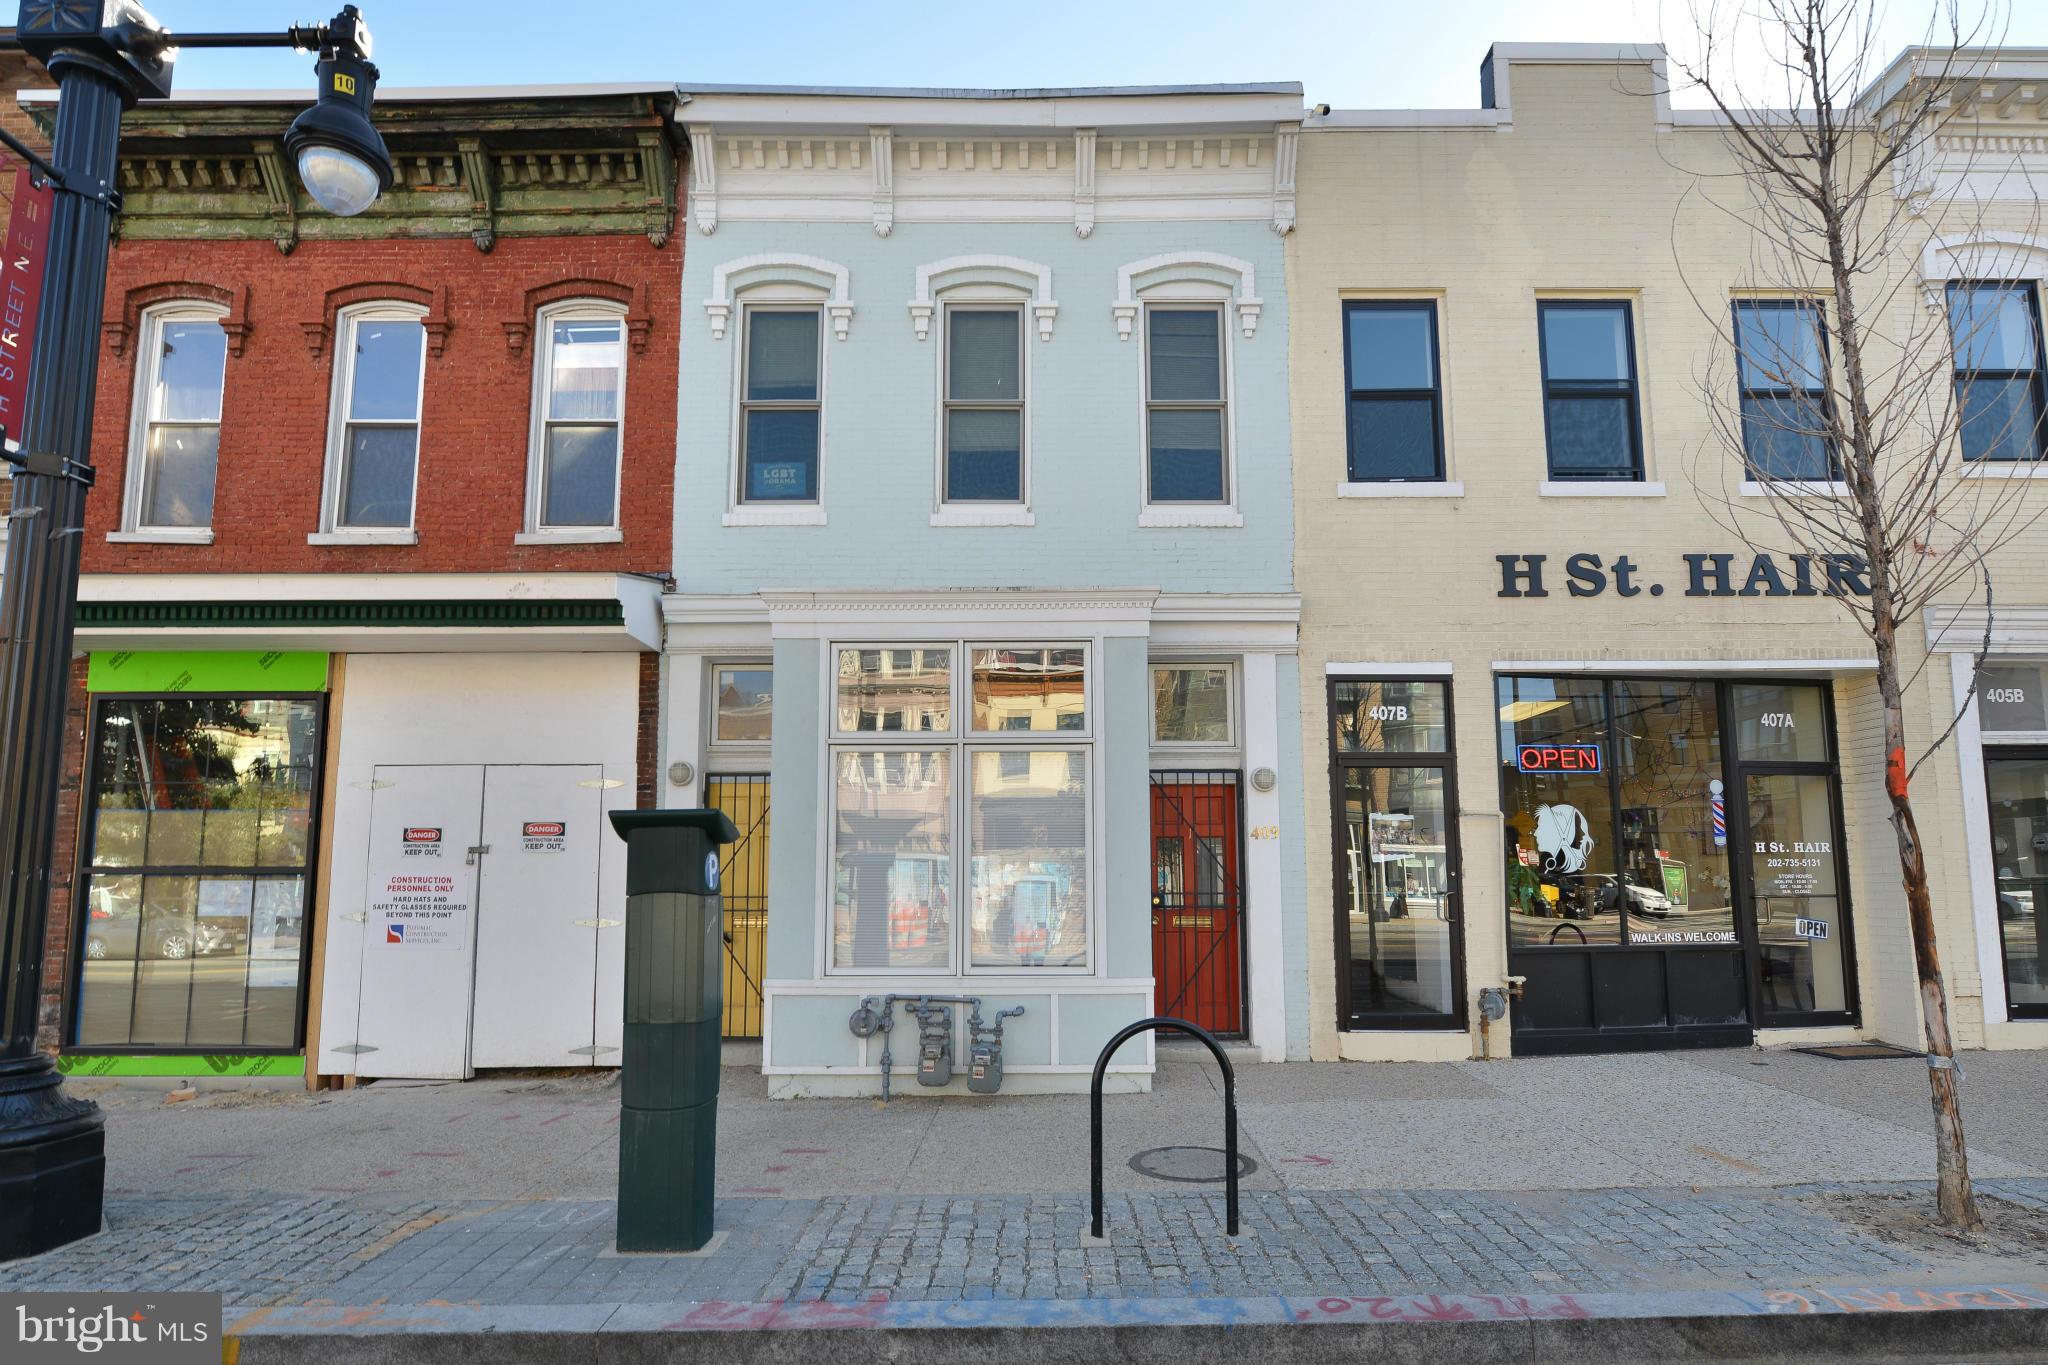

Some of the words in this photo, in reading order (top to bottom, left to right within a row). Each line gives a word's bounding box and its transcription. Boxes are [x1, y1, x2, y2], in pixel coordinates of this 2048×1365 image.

[337, 76, 353, 90] 10
[0, 280, 26, 381] STREET
[1496, 554, 1549, 597] H
[1566, 553, 1664, 597] St.
[1683, 553, 1873, 596] HAIR
[1987, 688, 2025, 703] 405B
[1369, 705, 1408, 721] 407B
[1761, 712, 1796, 728] 407A
[1521, 748, 1597, 769] OPEN
[1754, 842, 1766, 853] H
[1769, 842, 1790, 853] St.
[1793, 842, 1831, 853] HAIR
[1767, 859, 1820, 867] 202-735-5131
[391, 876, 452, 884] CONSTRUCTION
[387, 885, 432, 893] PERSONNEL
[1799, 920, 1827, 937] OPEN
[1631, 933, 1682, 943] WALK-INS
[1684, 932, 1736, 942] WELCOME
